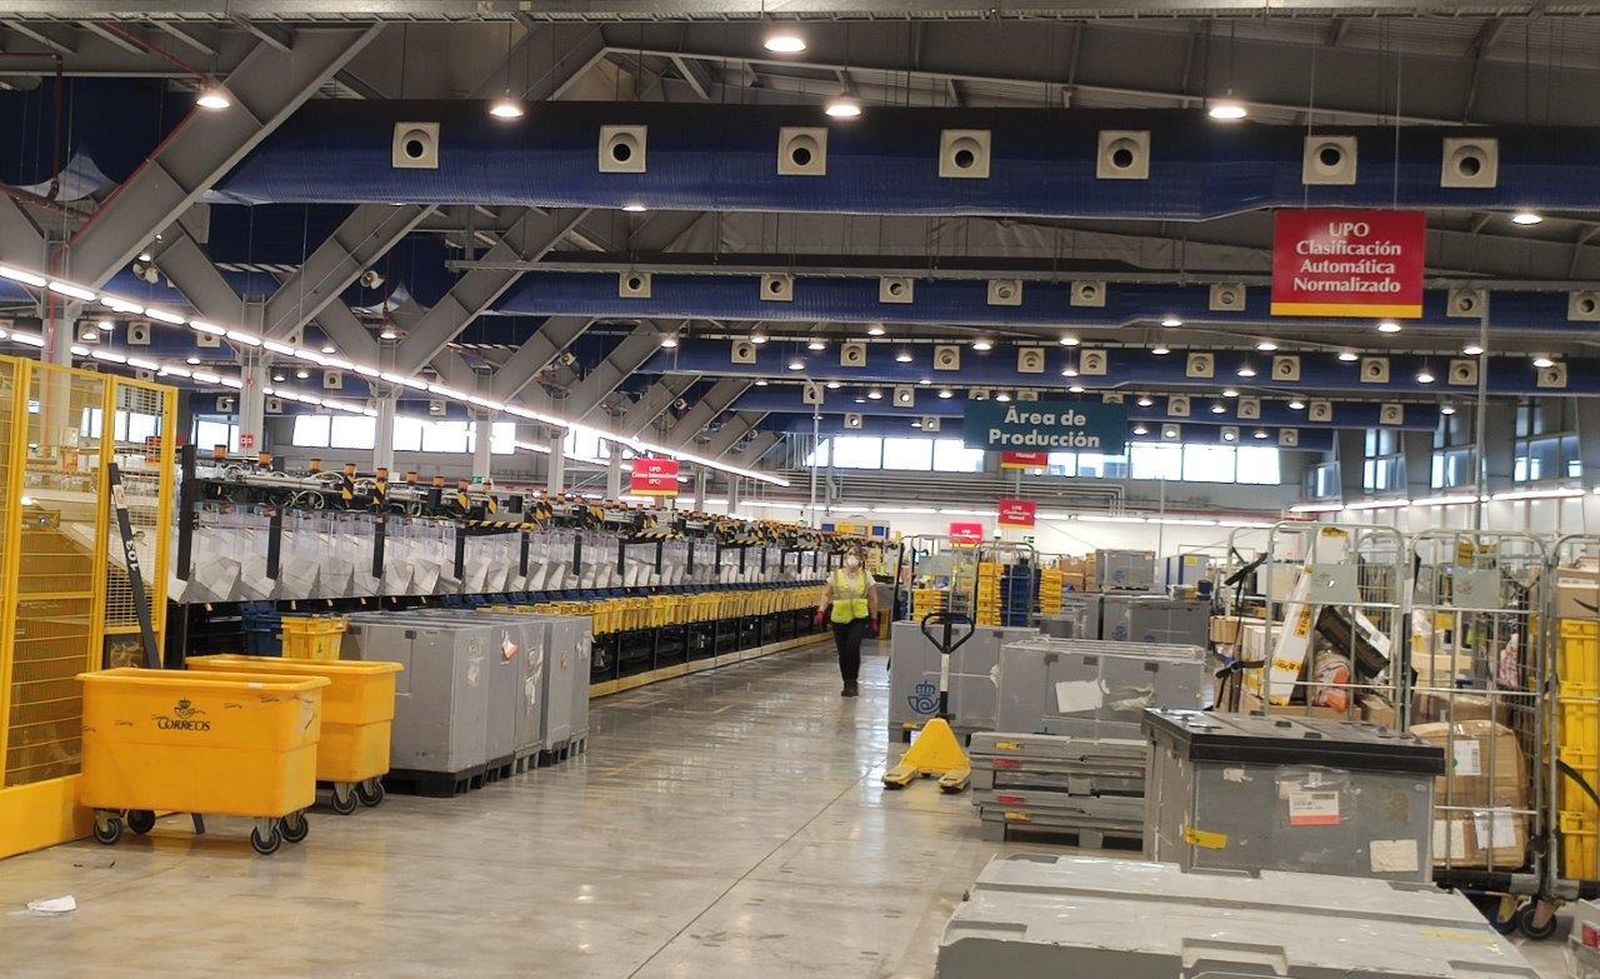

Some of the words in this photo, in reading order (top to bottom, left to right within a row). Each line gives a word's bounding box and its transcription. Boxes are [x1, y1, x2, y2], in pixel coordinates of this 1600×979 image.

[1328, 221, 1370, 238] UPO
[1296, 240, 1402, 256] Clasificación
[1300, 258, 1396, 275] Automática
[1293, 276, 1401, 293] Normalizado
[1004, 405, 1056, 425] Área
[1060, 409, 1087, 427] de
[988, 428, 1100, 448] Producción
[125, 540, 139, 571] 103
[157, 716, 211, 732] CORREOS
